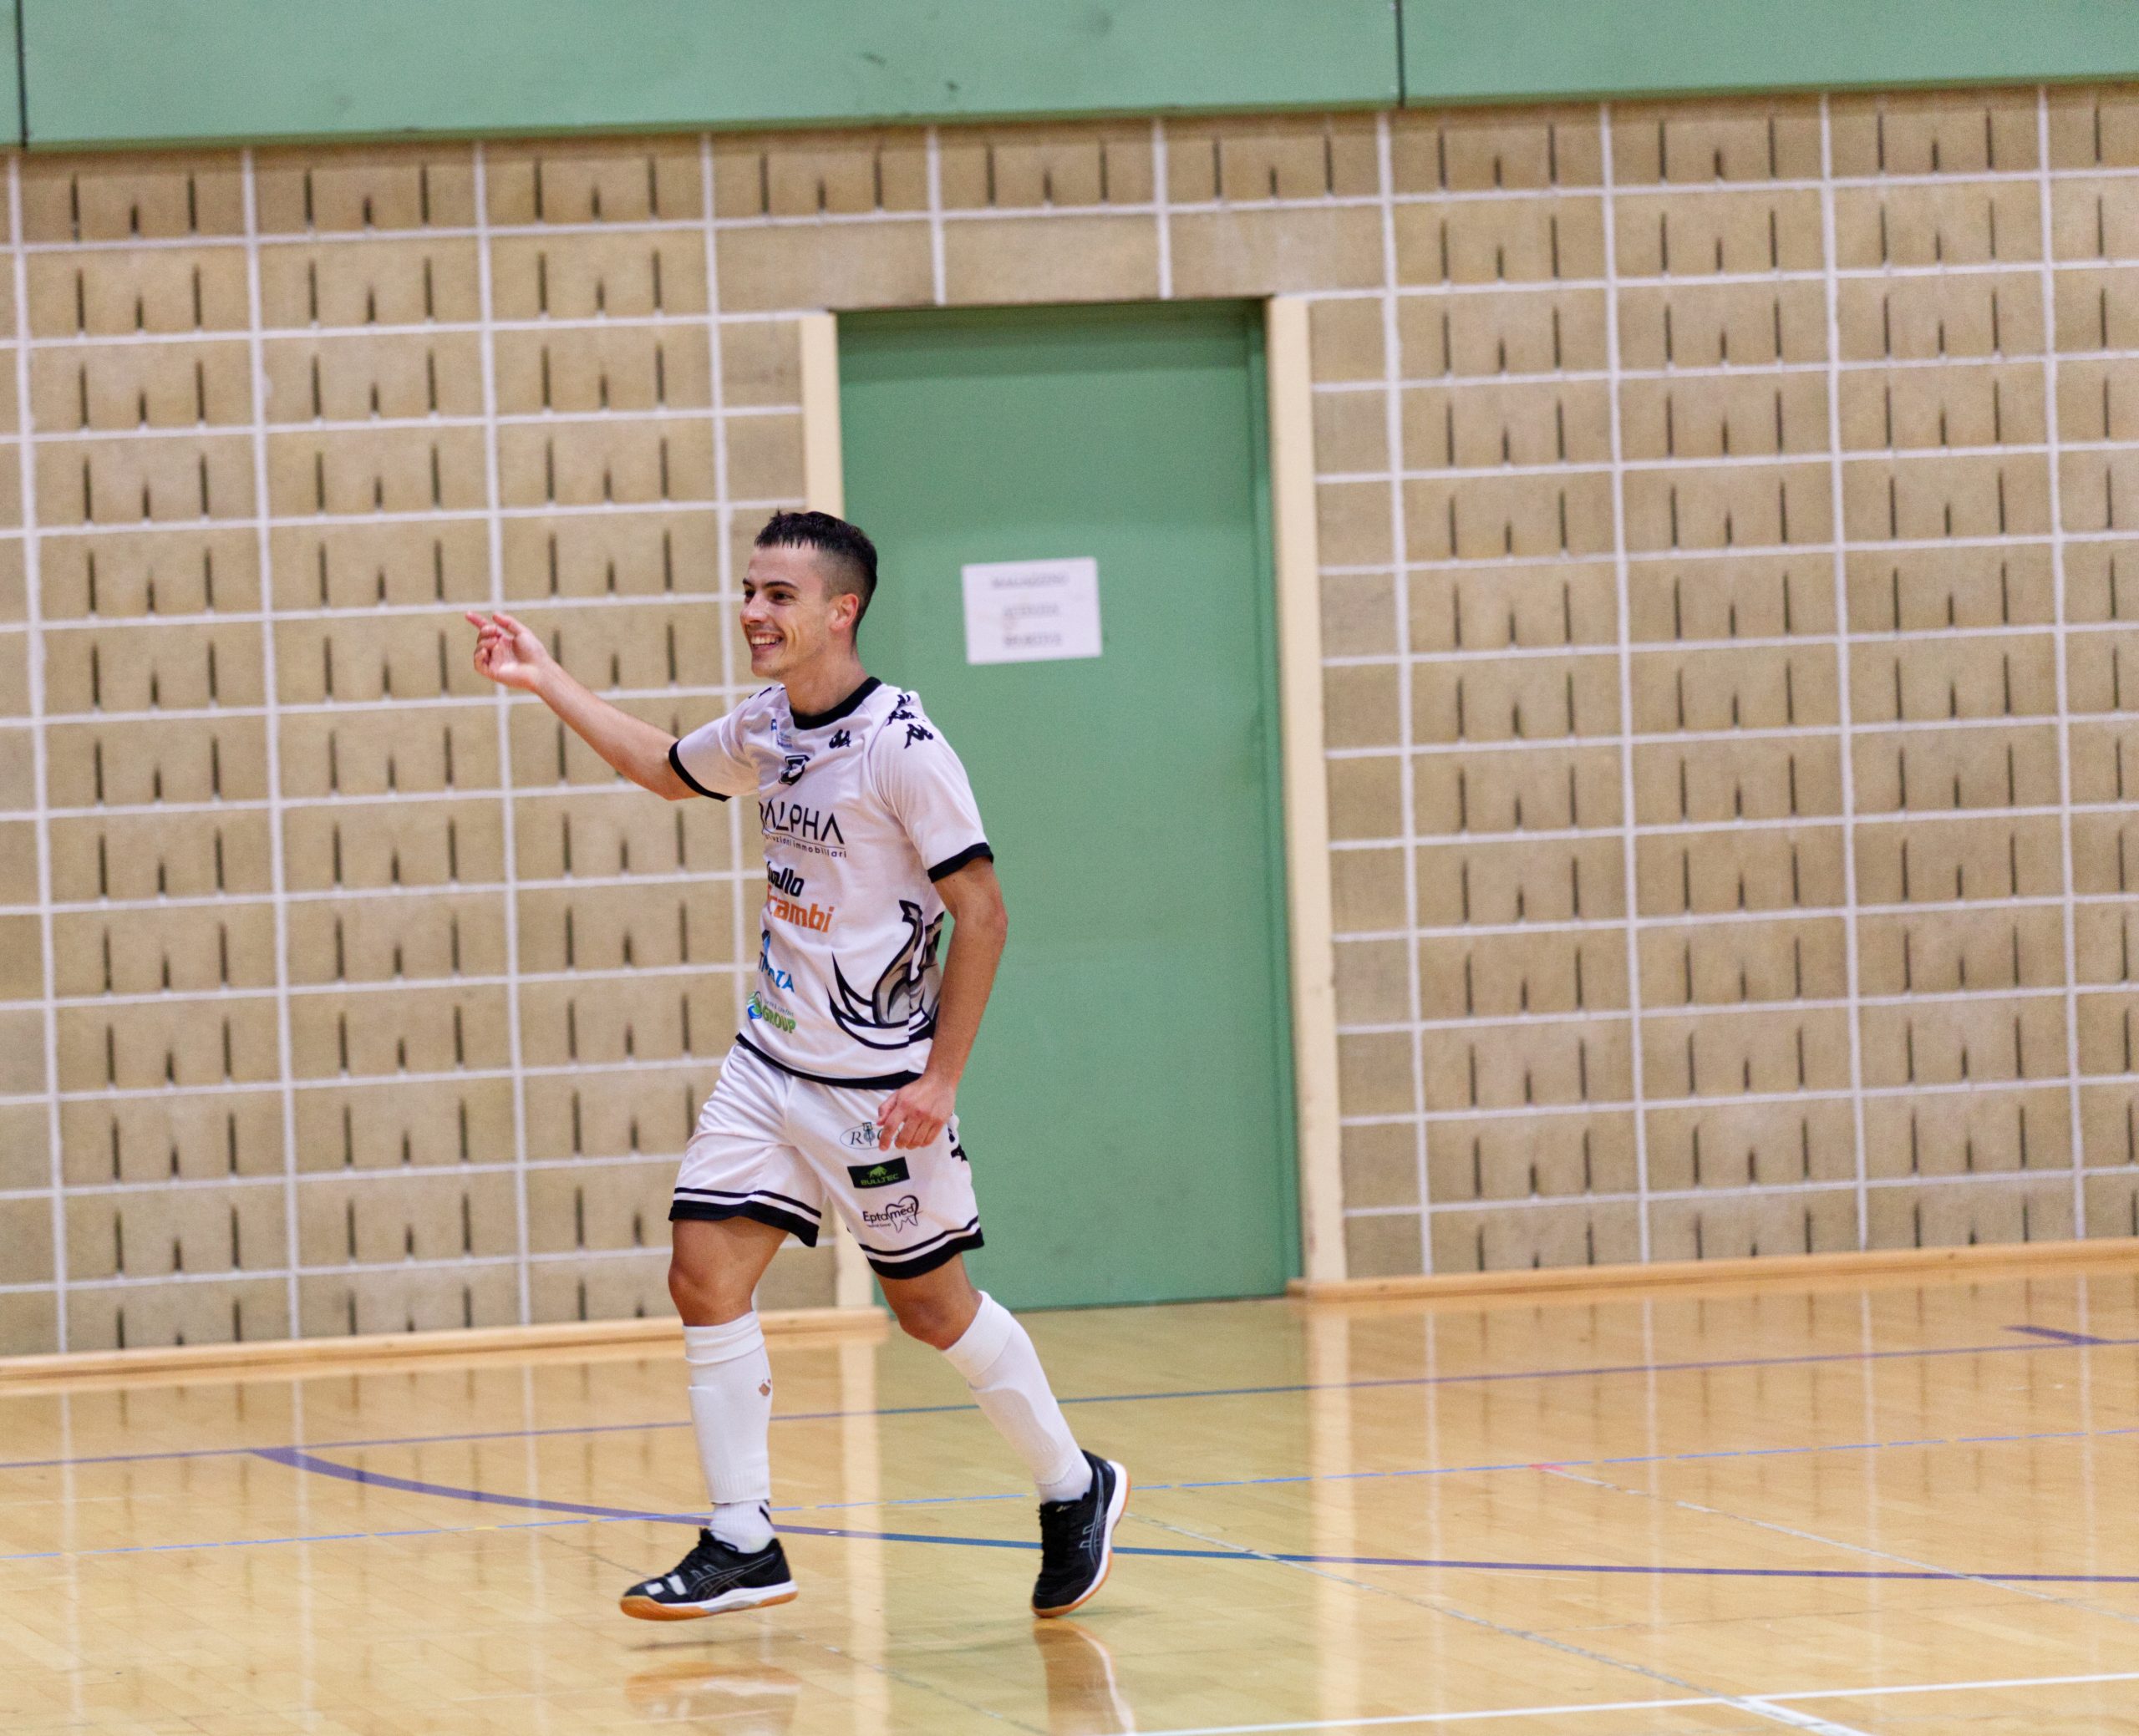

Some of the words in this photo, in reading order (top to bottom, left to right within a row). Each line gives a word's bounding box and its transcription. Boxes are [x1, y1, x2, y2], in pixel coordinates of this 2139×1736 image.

[762, 1005, 796, 1033] GROUP
[860, 1174, 900, 1185] BULLTEC
[862, 1202, 915, 1224] Eptamed
